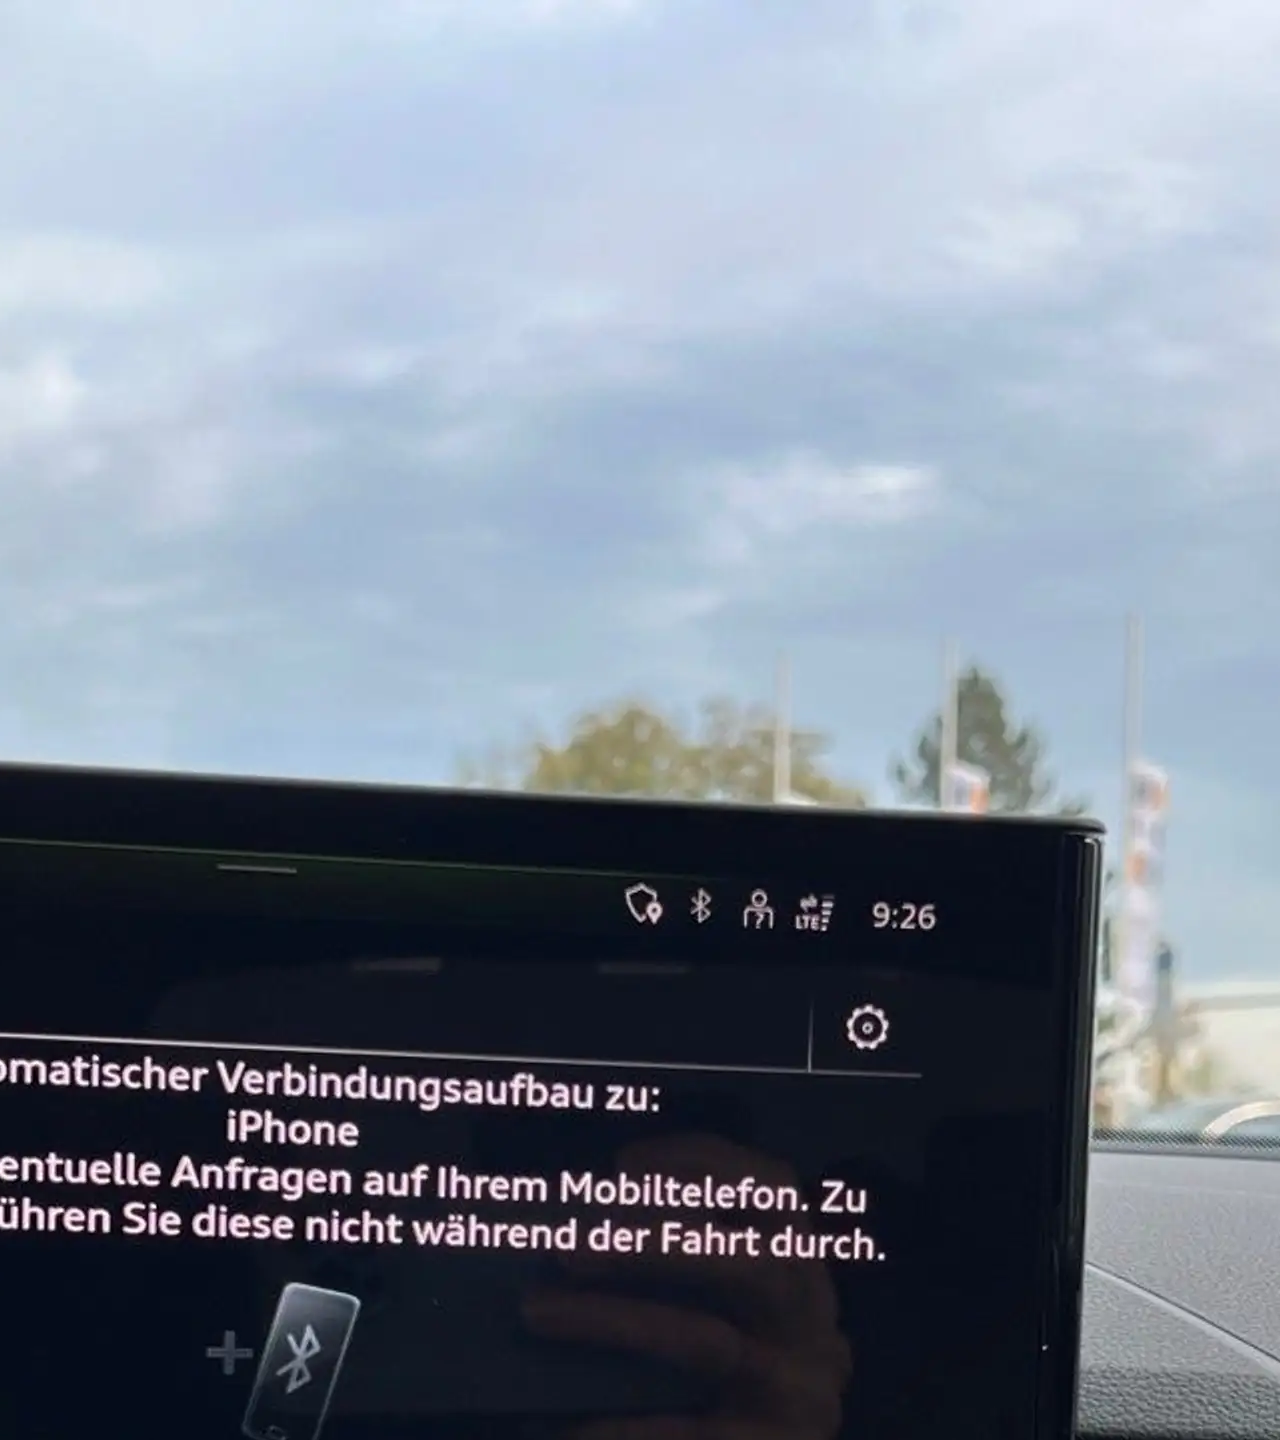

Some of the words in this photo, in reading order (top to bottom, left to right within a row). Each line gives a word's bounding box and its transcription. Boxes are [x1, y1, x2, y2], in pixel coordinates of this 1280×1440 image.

[872, 902, 936, 930] 9:26
[216, 1059, 594, 1112] Verbindungsaufbau
[604, 1083, 660, 1113] zu:
[227, 1109, 360, 1148] iPhone
[170, 1154, 352, 1202] Anfragen
[362, 1163, 430, 1199] auf
[436, 1164, 548, 1204] Ihrem
[559, 1170, 809, 1213] Mobiltelefon.
[820, 1179, 867, 1214] Zu
[122, 1200, 182, 1237] Sie
[191, 1203, 295, 1241] diese
[305, 1209, 404, 1245] nicht
[411, 1212, 578, 1252] während
[587, 1218, 652, 1254] der
[661, 1220, 762, 1258] Fahrt
[769, 1224, 886, 1261] durch.
